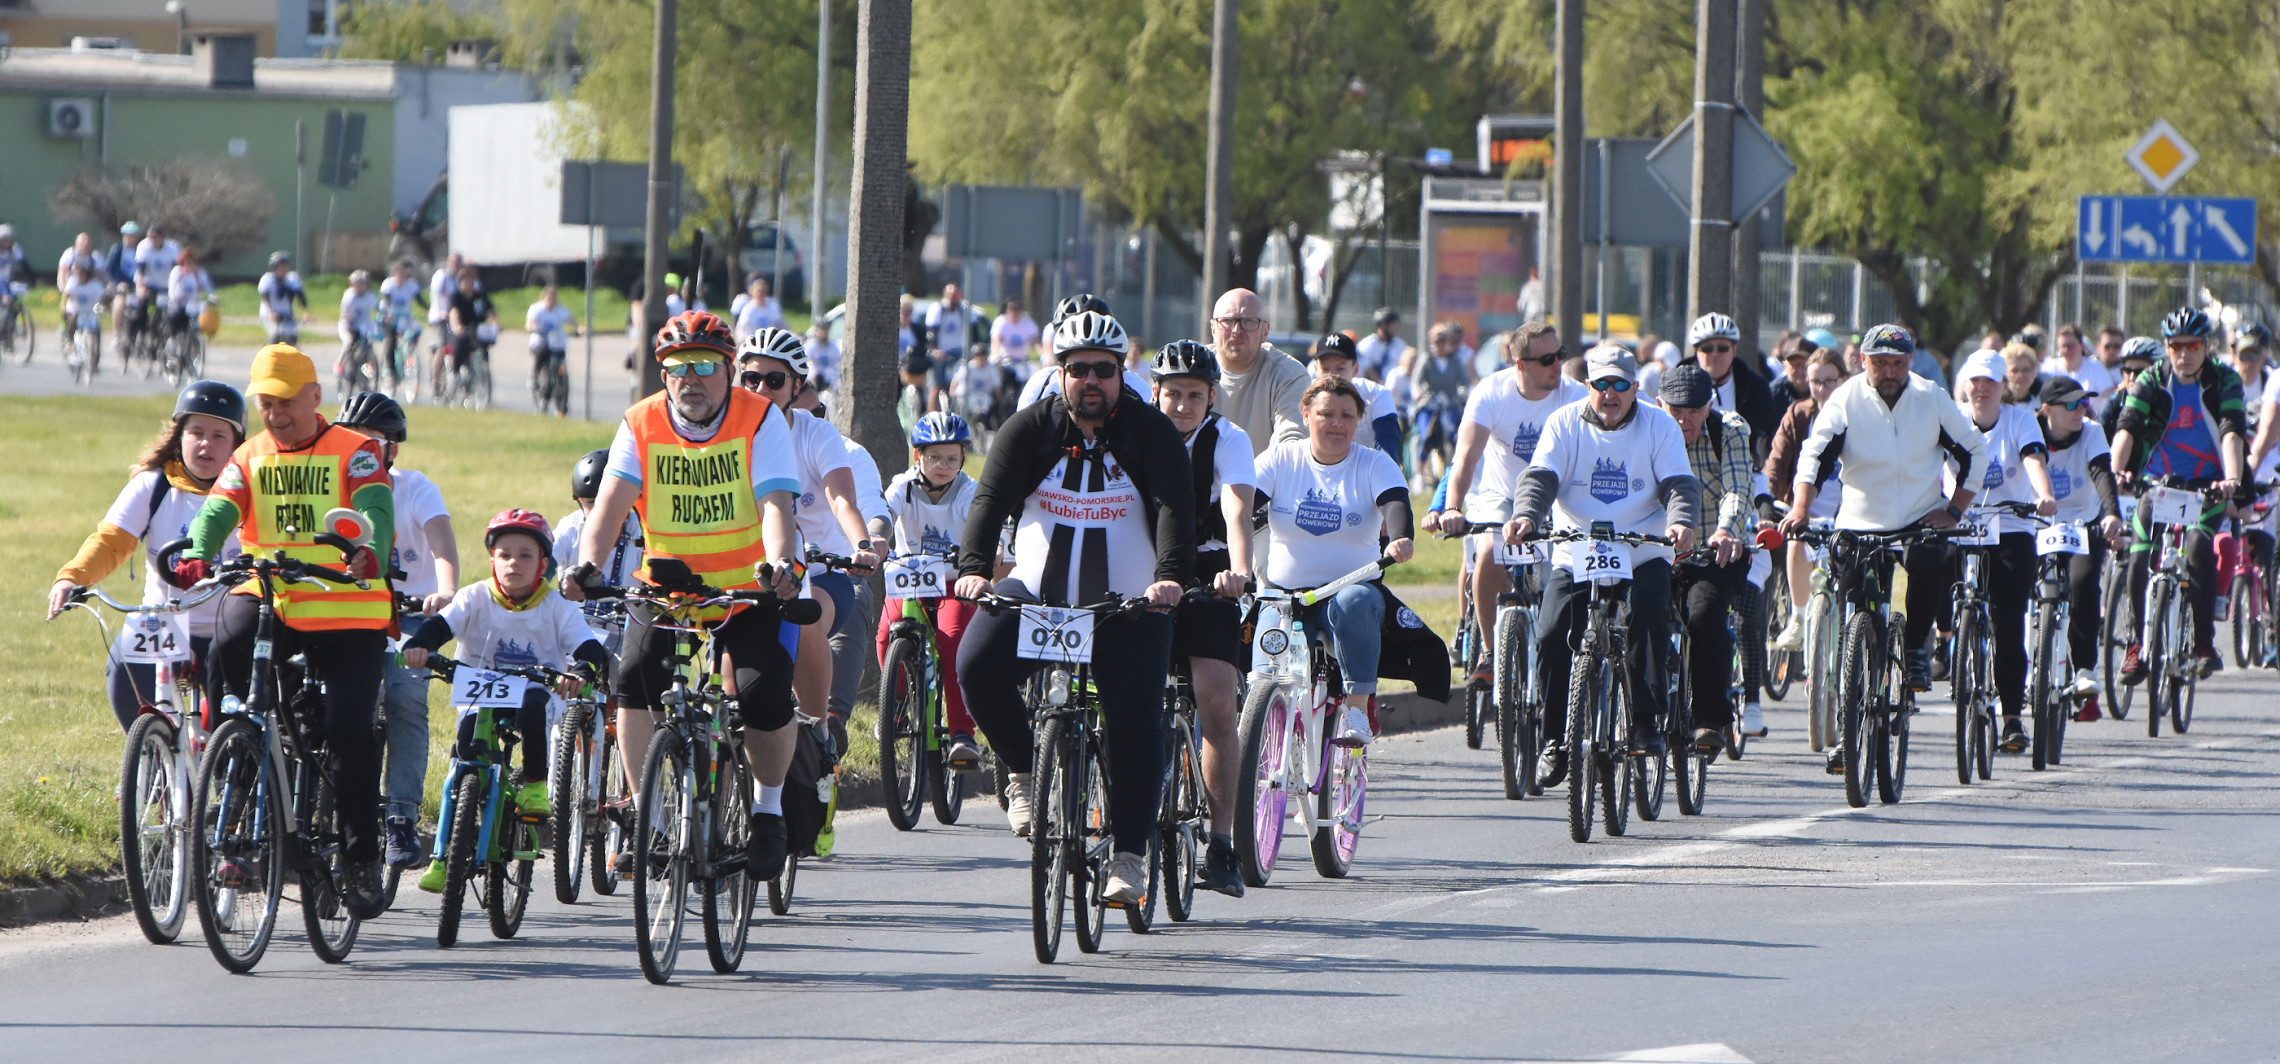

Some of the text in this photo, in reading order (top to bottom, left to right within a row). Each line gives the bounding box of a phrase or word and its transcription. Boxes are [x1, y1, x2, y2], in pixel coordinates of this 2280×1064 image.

[1591, 488, 1627, 496] ROWEROWY
[1592, 480, 1627, 489] PRZEJAZD
[672, 492, 735, 525] RUCHEM
[1039, 499, 1127, 521] #LubieTuByc
[1298, 509, 1340, 521] PRZEJAZD
[2179, 503, 2187, 518] 1
[1296, 518, 1339, 528] ROWEROWY
[2045, 535, 2081, 547] 038
[1585, 555, 1621, 571] 286
[895, 571, 937, 588] 030
[133, 632, 176, 652] 214
[1031, 627, 1082, 649] 070
[465, 680, 510, 699] 213
